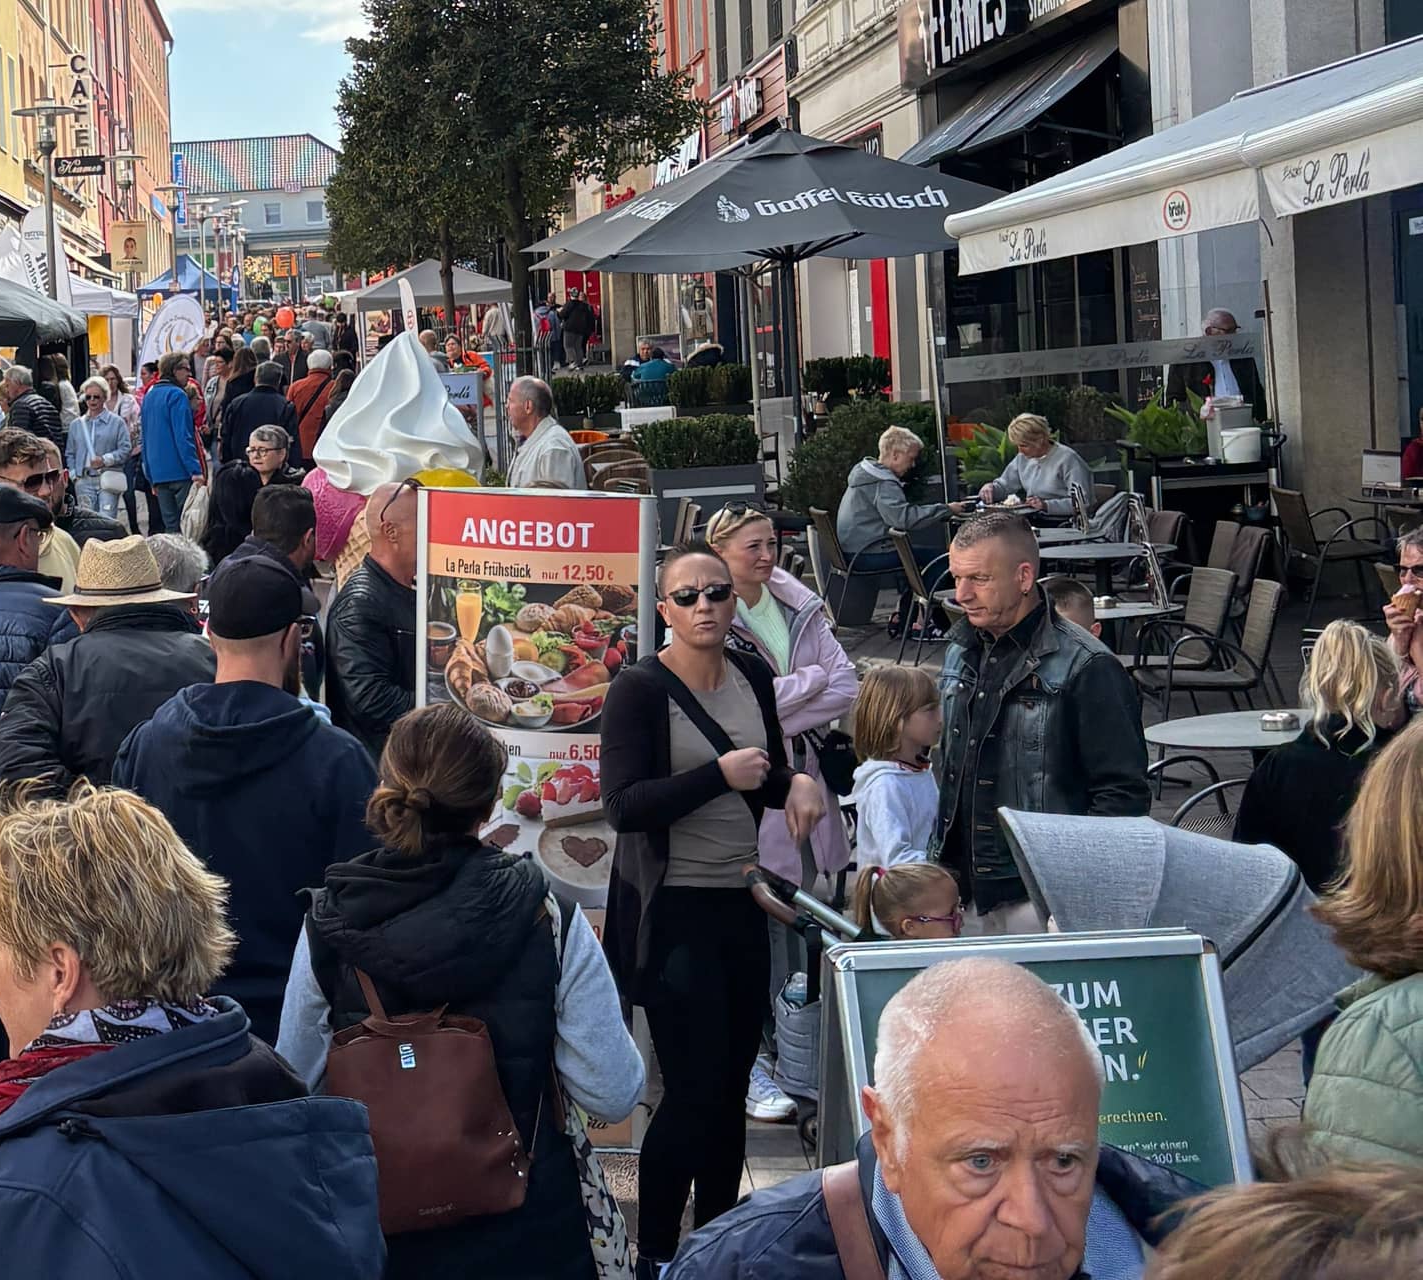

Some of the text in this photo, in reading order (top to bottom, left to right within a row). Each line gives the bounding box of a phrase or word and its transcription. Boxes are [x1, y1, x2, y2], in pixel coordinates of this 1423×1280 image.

[754, 184, 950, 216] Gaffel Kölsch
[461, 517, 595, 548] ANGEBOT
[445, 557, 614, 582] La Perla Frühstück nur 12,50 €
[549, 750, 567, 760] nur
[1099, 1110, 1167, 1124] erechnen.
